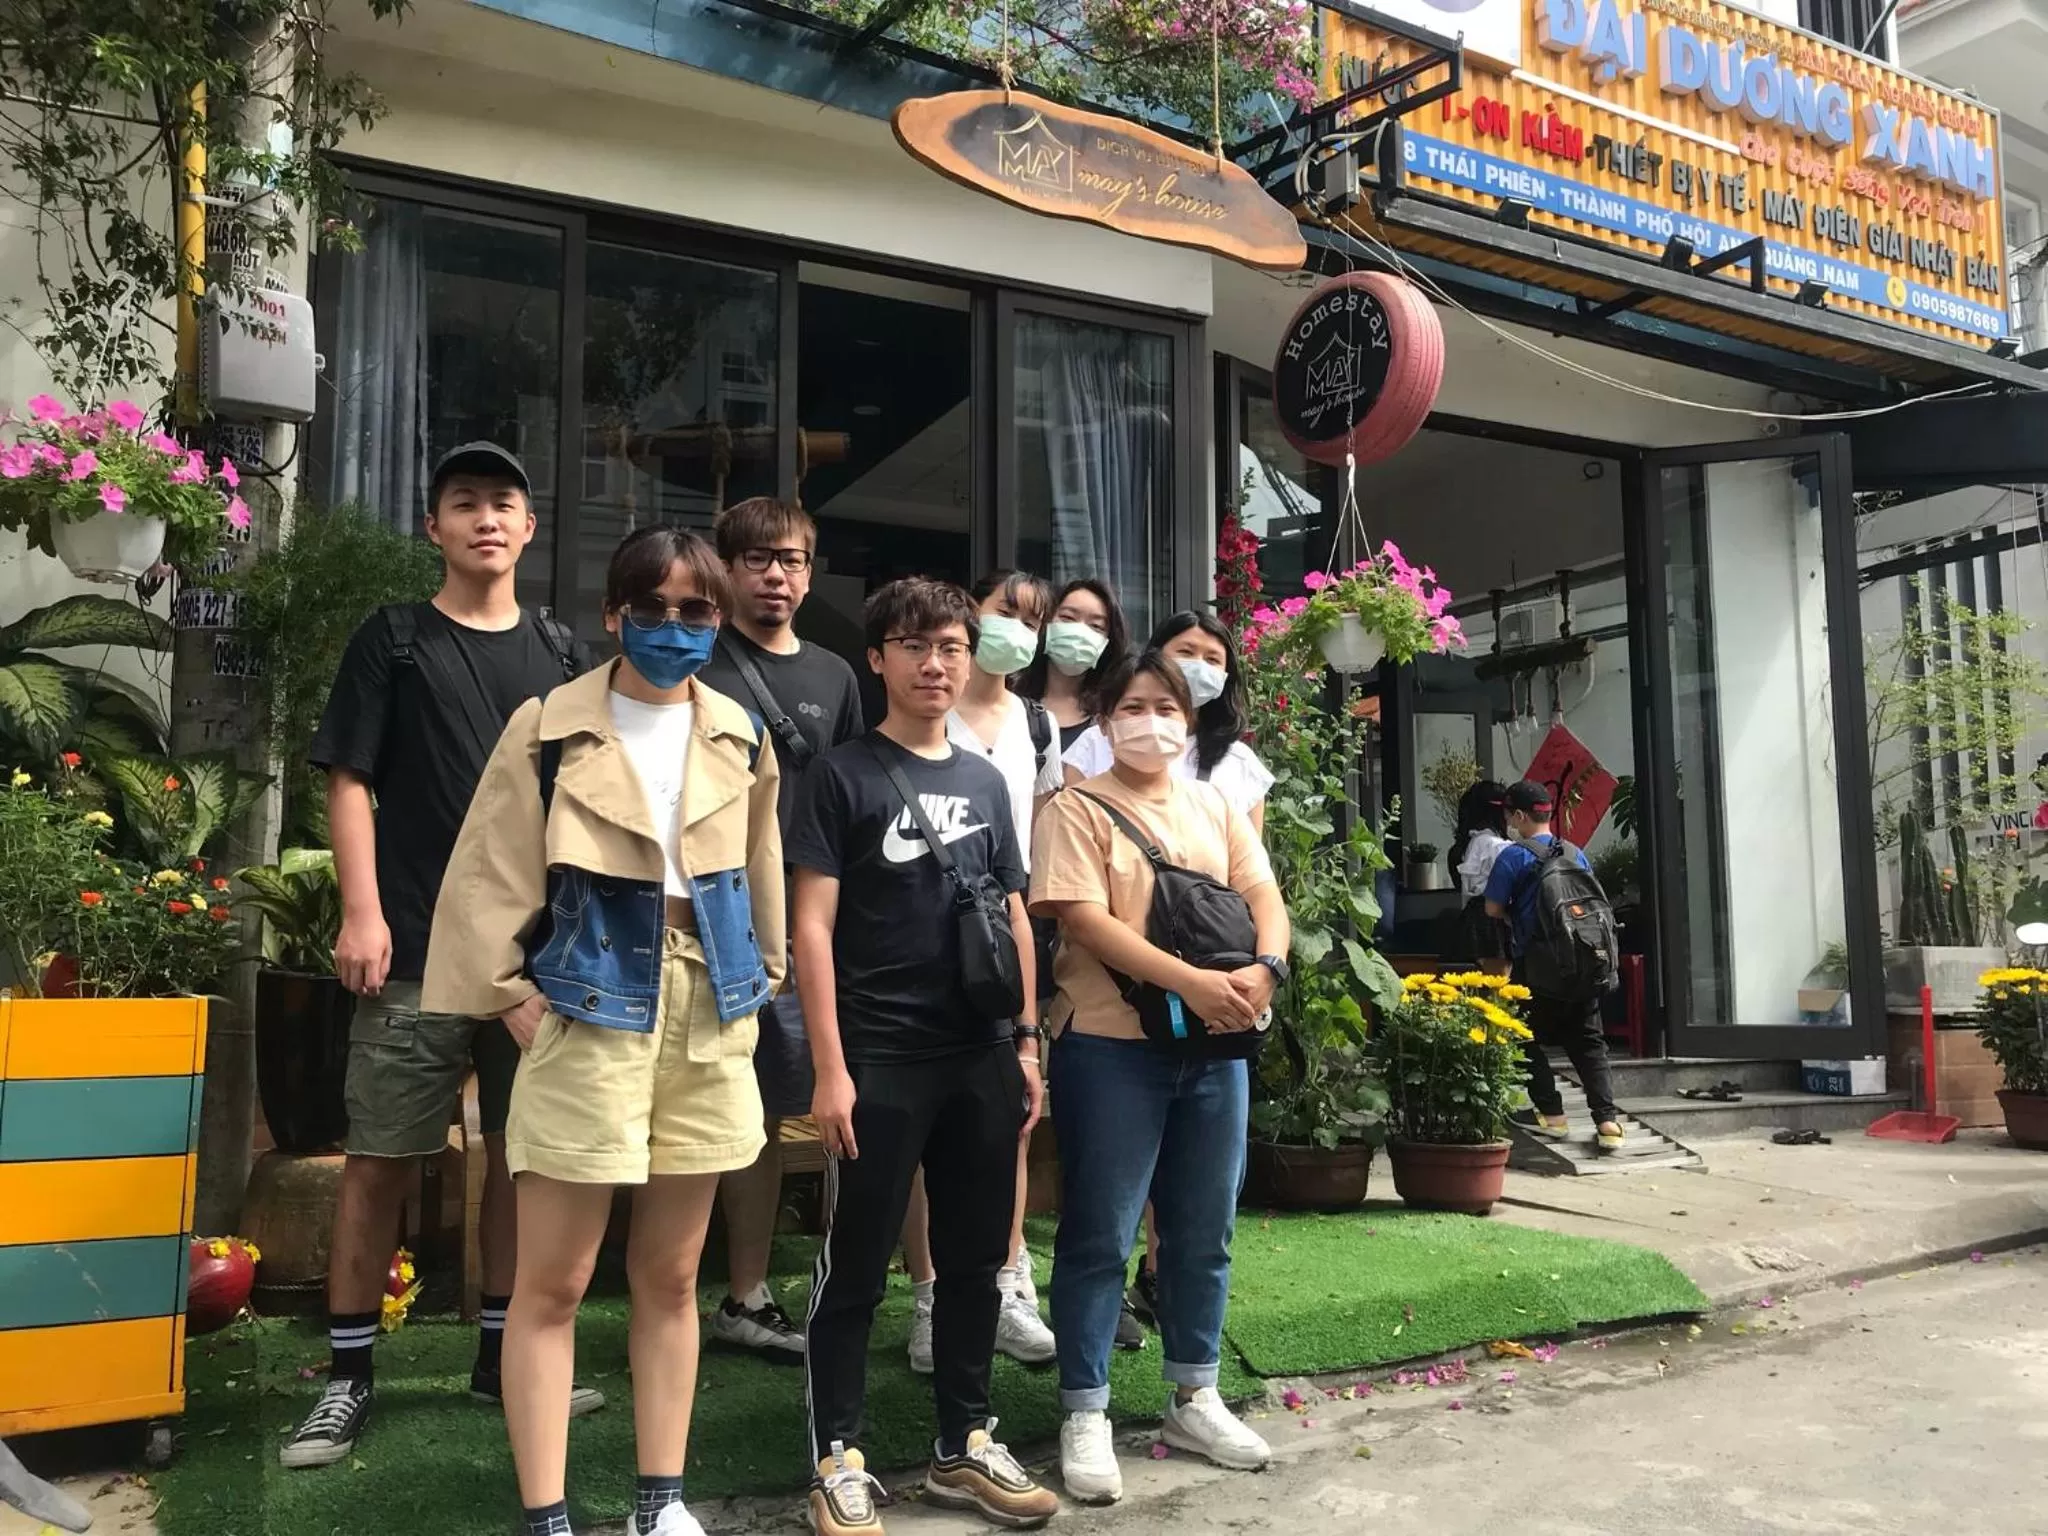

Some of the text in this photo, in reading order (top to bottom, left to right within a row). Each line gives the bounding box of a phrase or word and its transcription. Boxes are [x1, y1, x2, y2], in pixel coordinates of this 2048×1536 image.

[1659, 26, 1852, 146] DƯƠNG
[1862, 102, 1994, 200] XANH
[1740, 132, 1779, 166] Cho
[1078, 168, 1148, 219] may's
[1155, 173, 1230, 220] house
[1424, 146, 1477, 180] THÁI
[1485, 164, 1545, 200] PHIÊN
[1560, 187, 1626, 223] THÀNH
[1635, 209, 1674, 237] PHỐ
[1680, 222, 1712, 250] HỘI
[1823, 264, 1859, 290] NAM
[1521, 102, 1583, 163] KIỀM
[1593, 134, 1663, 187] THIẾT
[1671, 158, 1695, 207] BỊ
[1698, 167, 1714, 203] Y
[1762, 187, 1807, 230] MÁY
[1814, 205, 1861, 251] ĐIỆN
[1909, 236, 1957, 282] NHẬT
[1285, 293, 1389, 361] Homestay
[1911, 290, 2000, 335] 0905987669
[899, 793, 970, 831] NIKE
